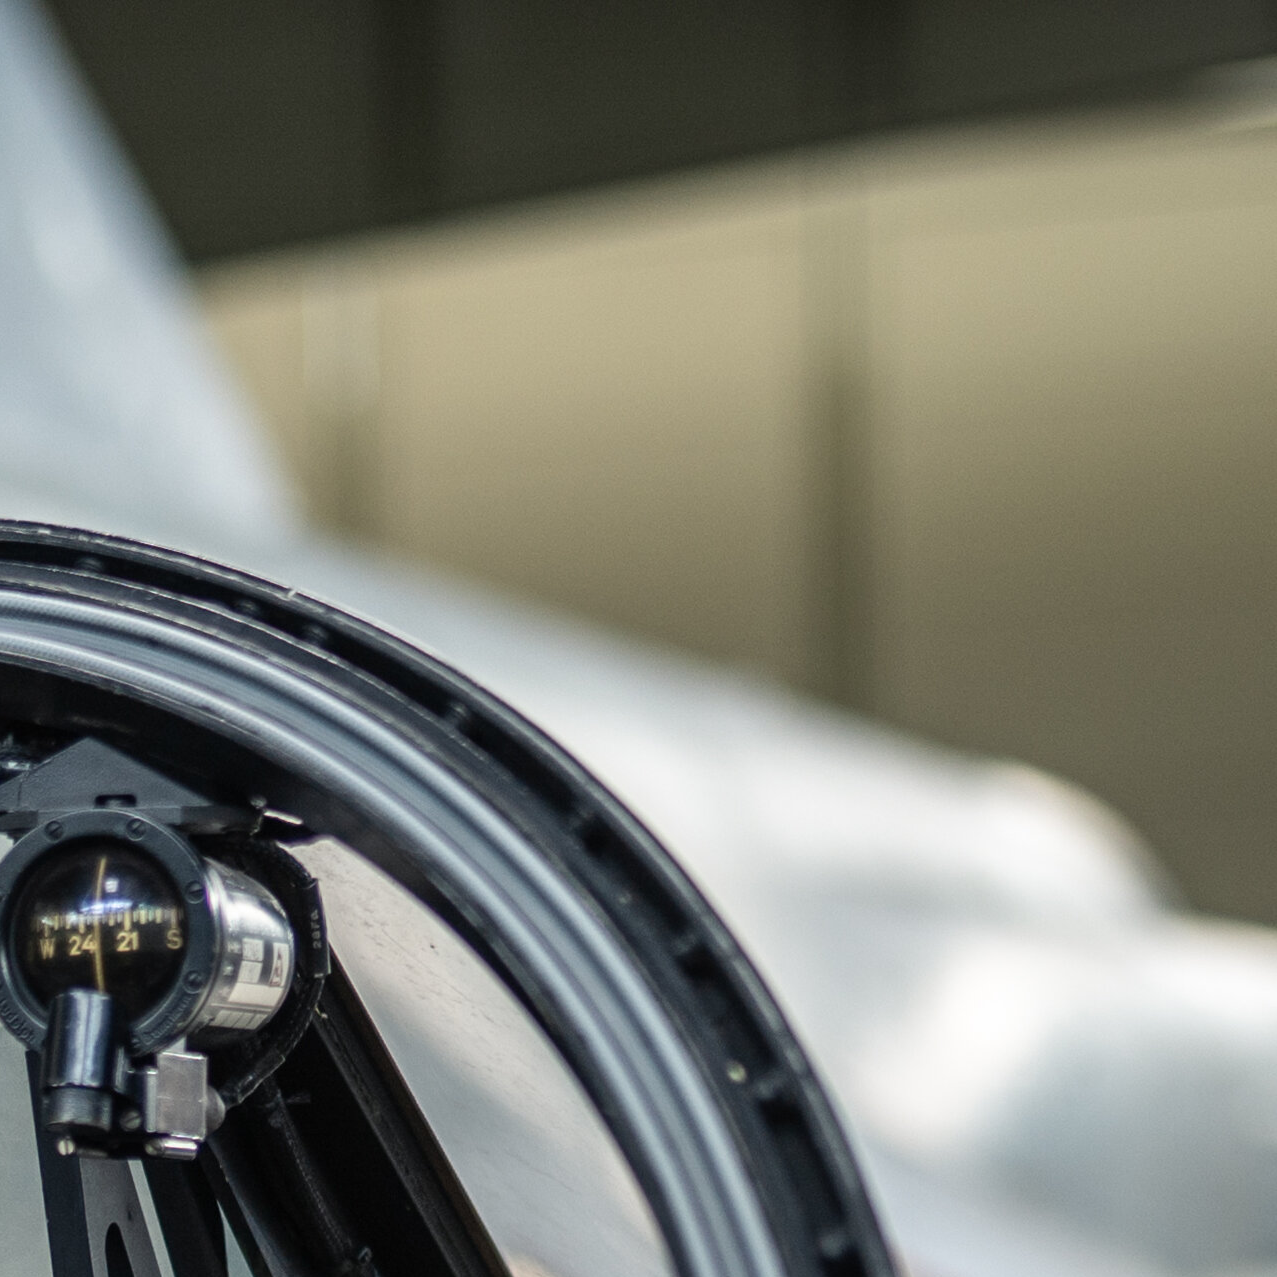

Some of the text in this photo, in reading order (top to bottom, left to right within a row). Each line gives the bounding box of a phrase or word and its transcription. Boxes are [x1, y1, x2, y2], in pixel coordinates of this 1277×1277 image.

[69, 936, 95, 957] 24
[117, 934, 138, 952] 21
[166, 930, 183, 950] S
